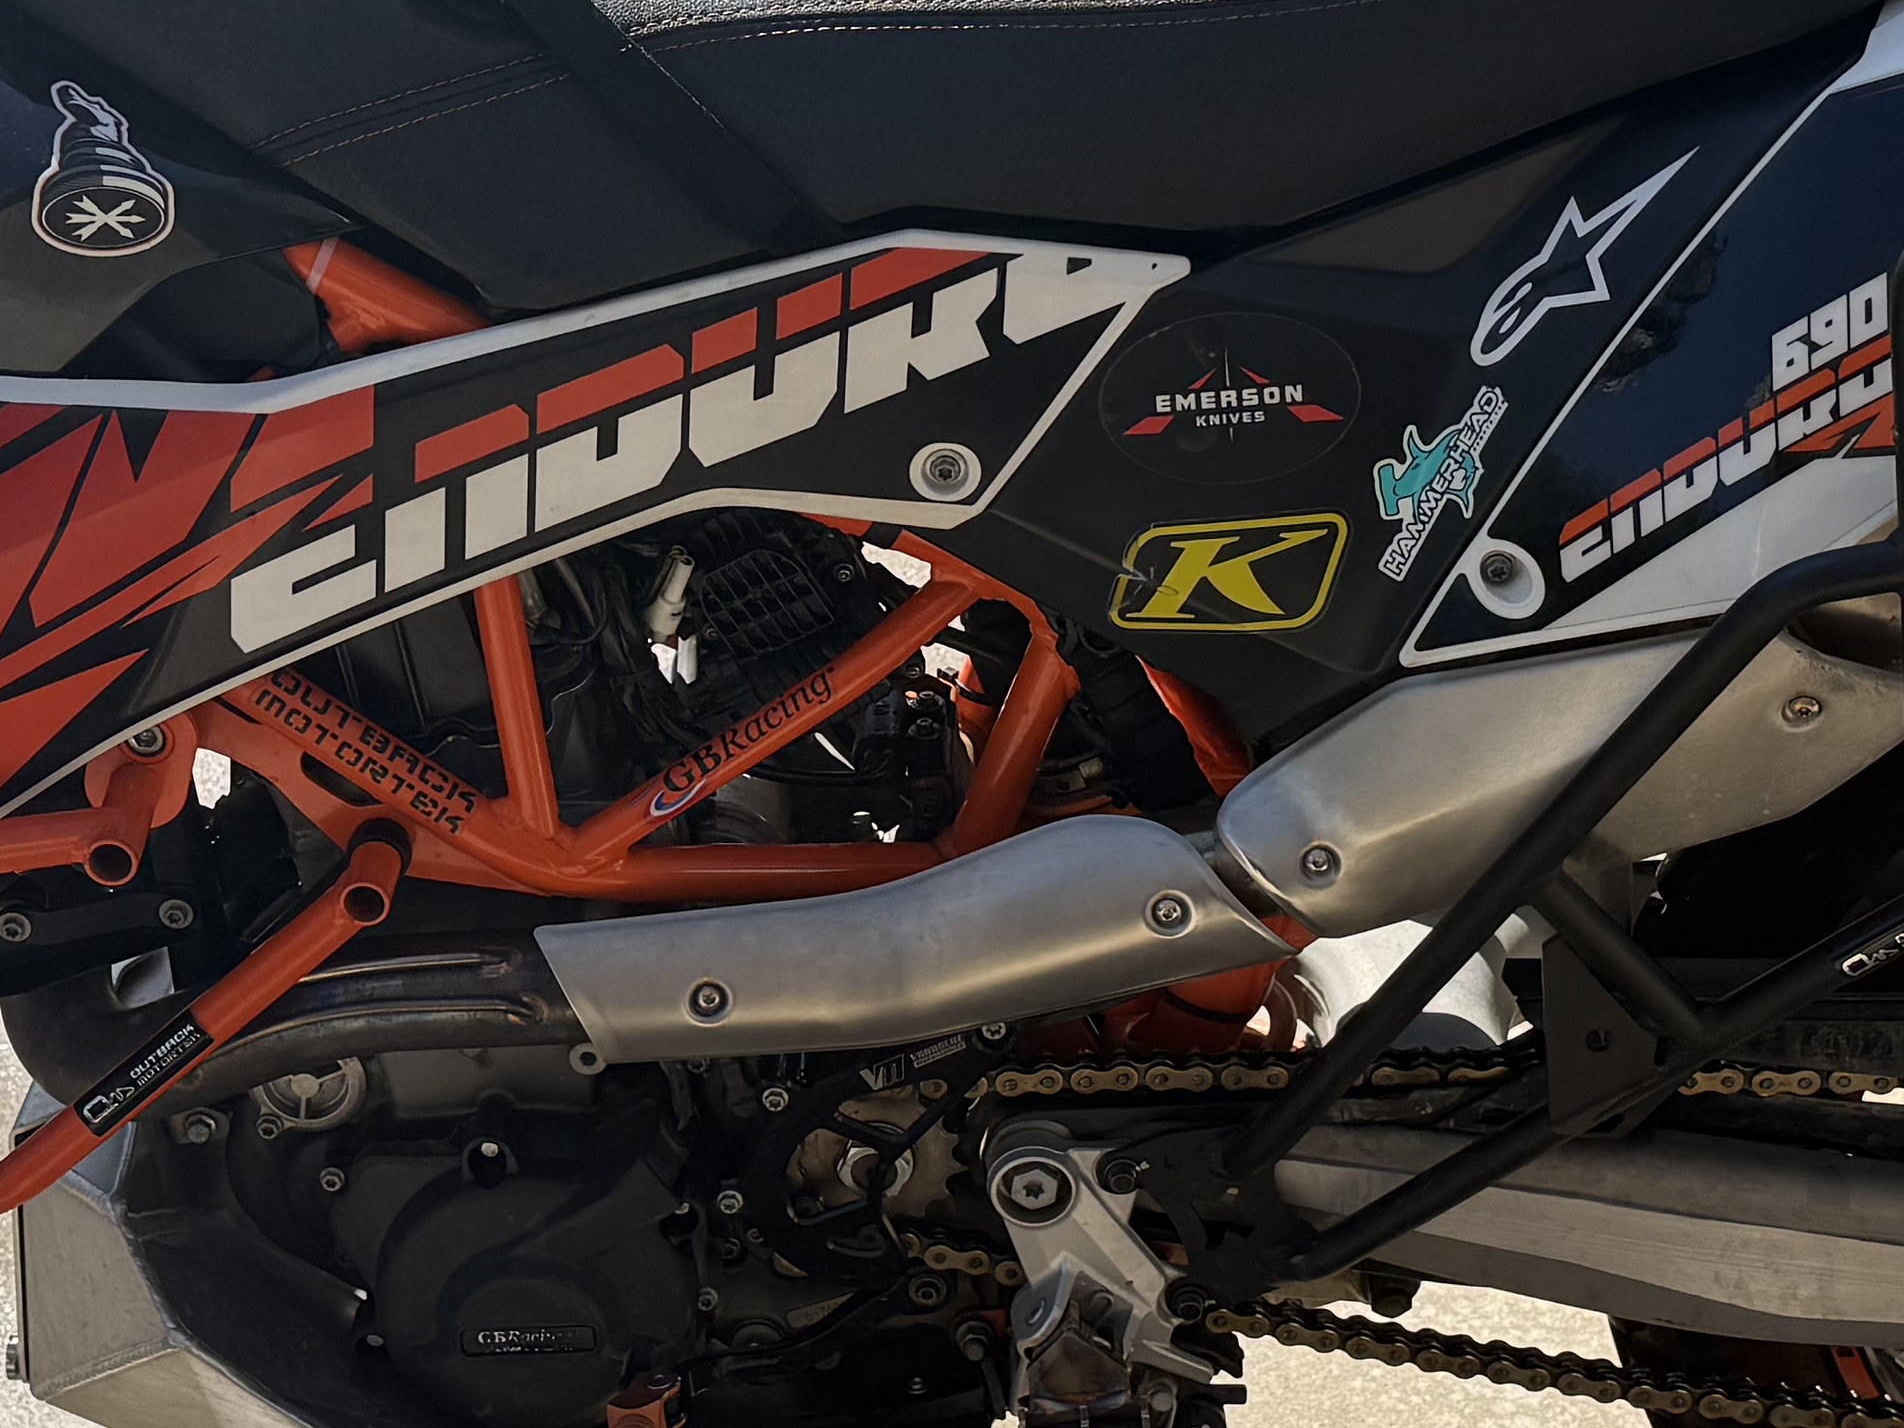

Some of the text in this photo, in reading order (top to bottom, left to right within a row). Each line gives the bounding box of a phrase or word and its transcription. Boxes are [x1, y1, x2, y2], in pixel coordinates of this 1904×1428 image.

[1772, 272, 1889, 393] 690
[1155, 383, 1304, 415] EMERSON
[1195, 409, 1265, 428] KNIVES
[1558, 335, 1894, 583] ENDURO
[1384, 386, 1500, 580] HAMMERHEAD
[254, 689, 463, 836] MOTORTEK
[271, 667, 477, 814] OUTBACK
[663, 669, 832, 792] GBRacing
[129, 1022, 195, 1080] OUTBACK
